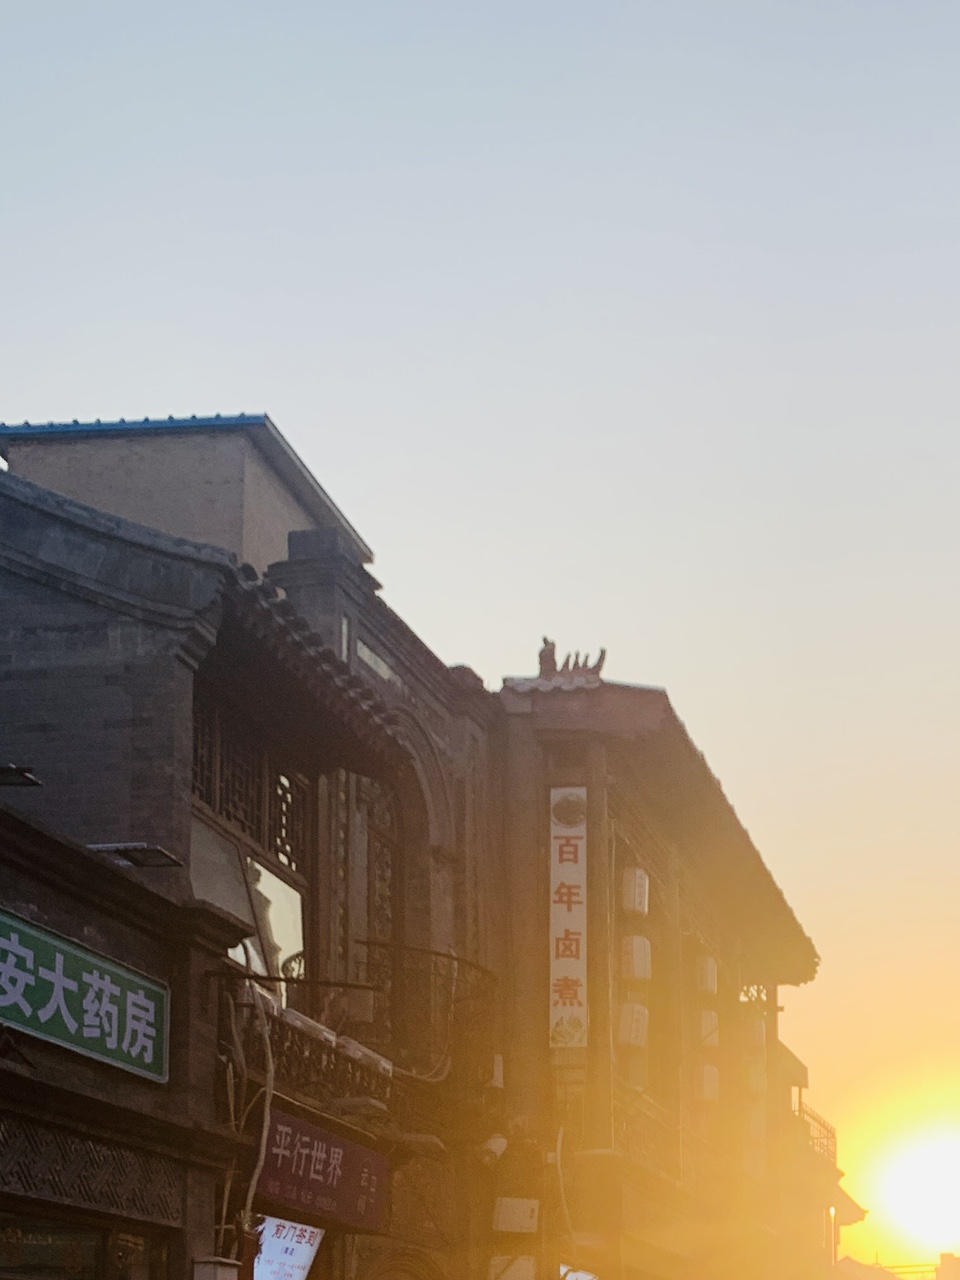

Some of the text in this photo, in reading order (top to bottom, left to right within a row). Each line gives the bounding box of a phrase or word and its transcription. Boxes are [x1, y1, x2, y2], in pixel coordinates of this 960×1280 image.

[552, 835, 584, 1007] 百年卤煮
[0, 932, 157, 1063] 安大药房
[272, 1124, 343, 1188] 平行世界
